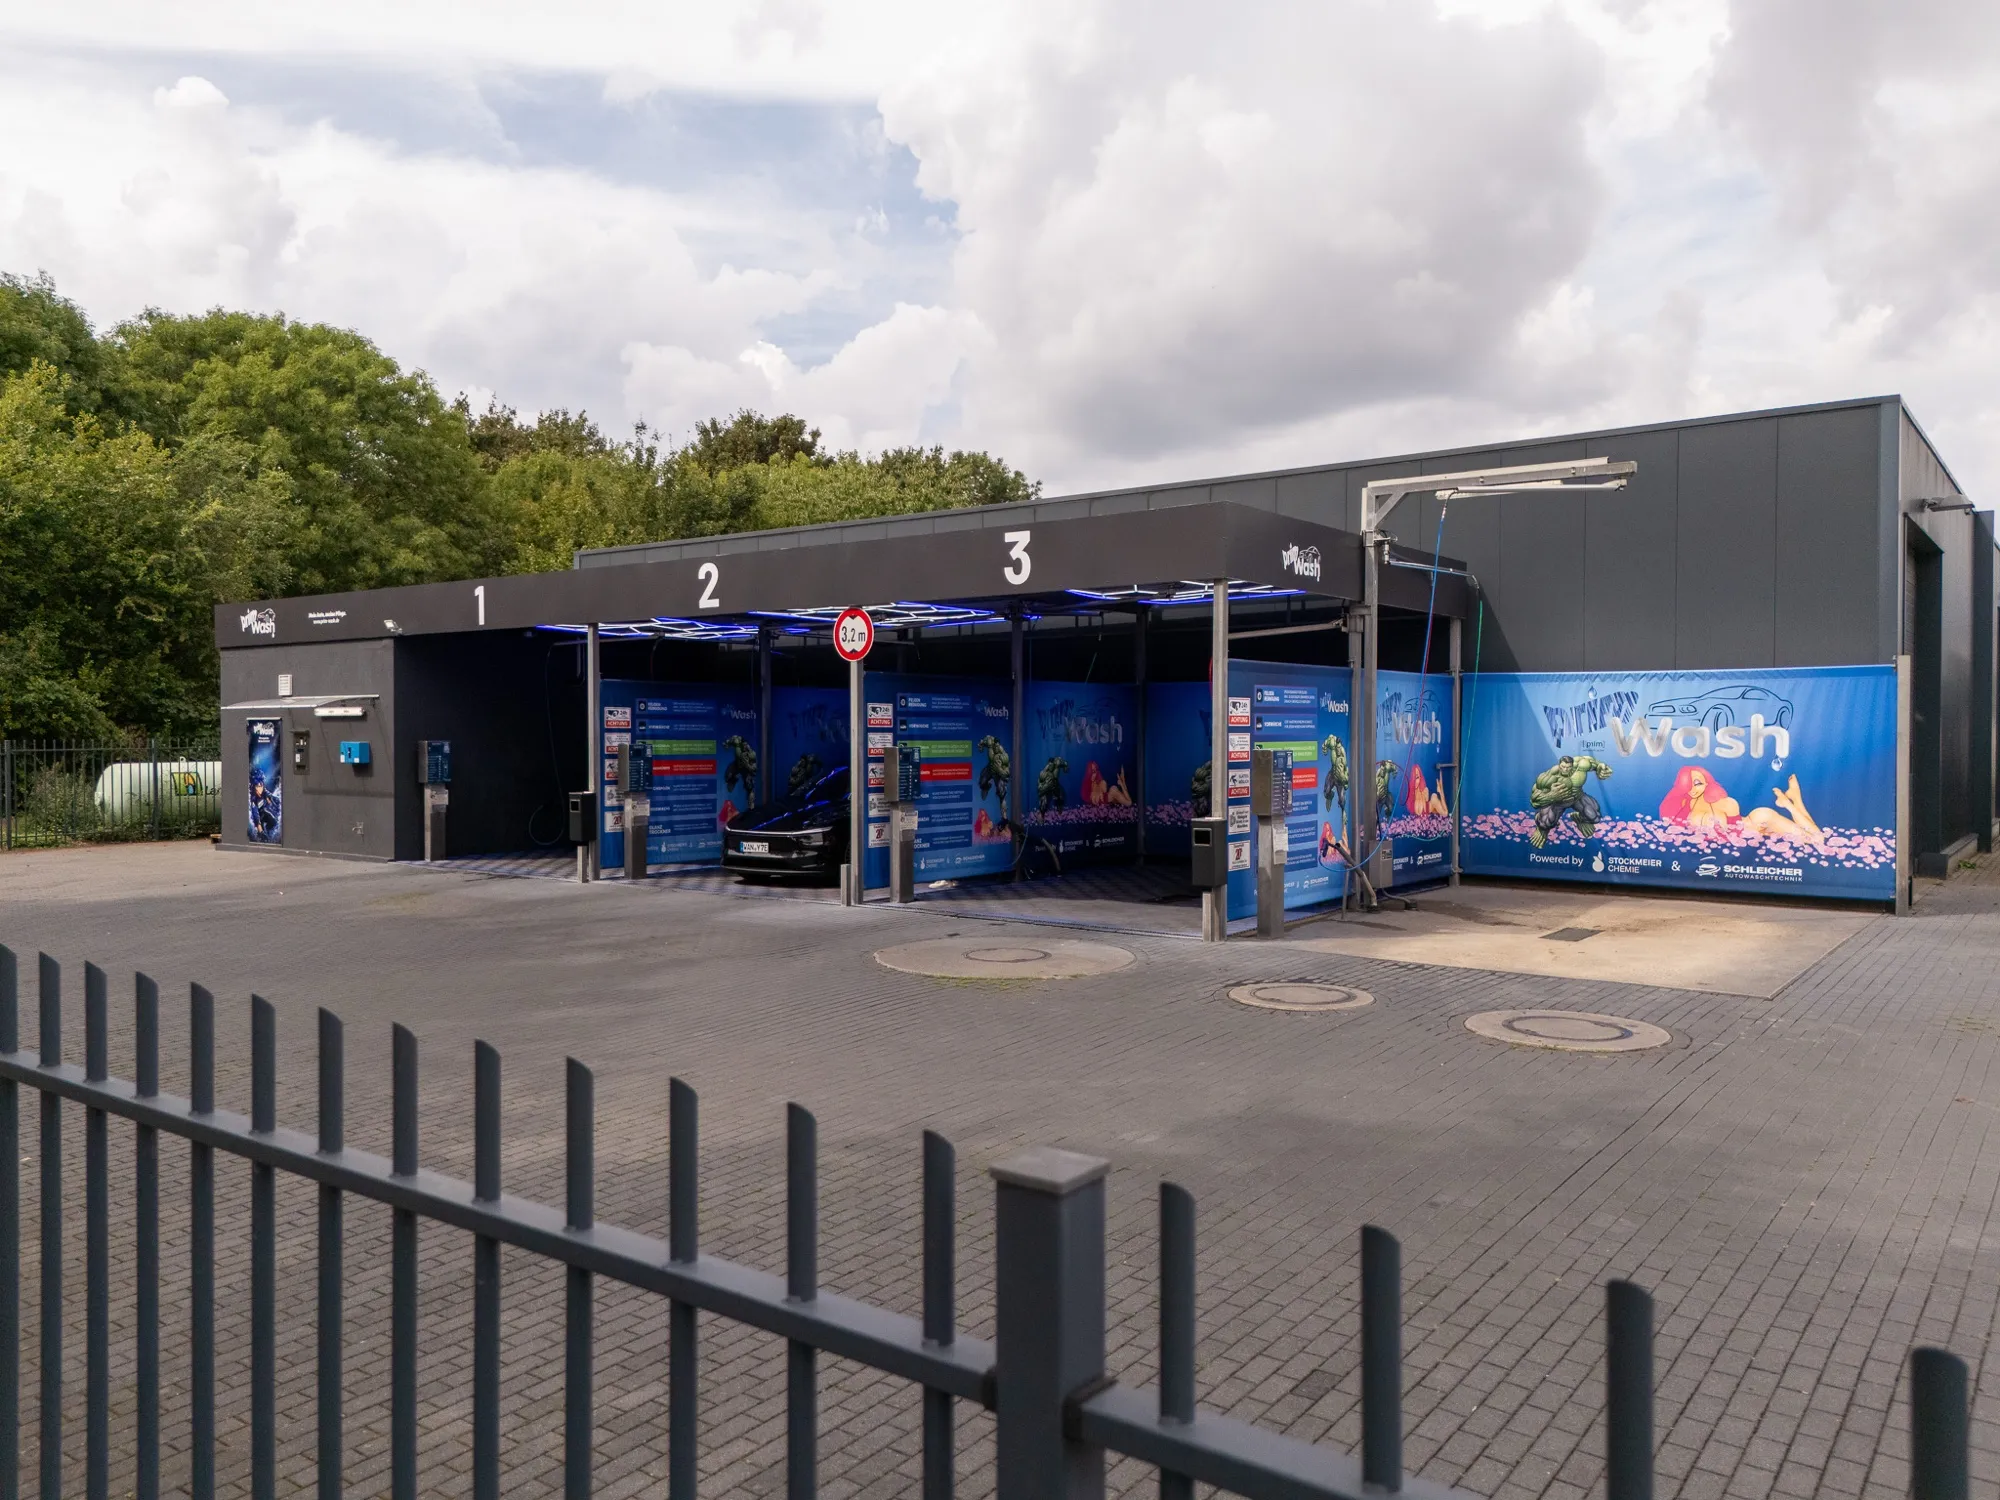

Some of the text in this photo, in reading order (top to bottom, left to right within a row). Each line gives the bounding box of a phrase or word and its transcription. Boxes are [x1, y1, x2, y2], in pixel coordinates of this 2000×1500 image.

[1004, 530, 1031, 585] 3
[1294, 557, 1321, 577] Wash
[698, 562, 720, 609] 2
[474, 585, 485, 626] 1
[251, 619, 275, 634] Wash
[841, 626, 866, 643] 3,2 m
[730, 709, 757, 719] Wash
[984, 706, 1009, 717] Wash
[1327, 700, 1349, 714] Wash
[1063, 715, 1123, 745] Wash
[1392, 711, 1442, 745] Wash
[1611, 713, 1790, 759] Wash
[1230, 751, 1249, 759] ACHTUNG
[1230, 786, 1248, 795] ACHTUNG
[1529, 853, 1803, 876] Powered by STOCKMEIER & SCHLEICHER
[1608, 865, 1803, 882] CHEMIE AUTOWASCHTECHNIK
